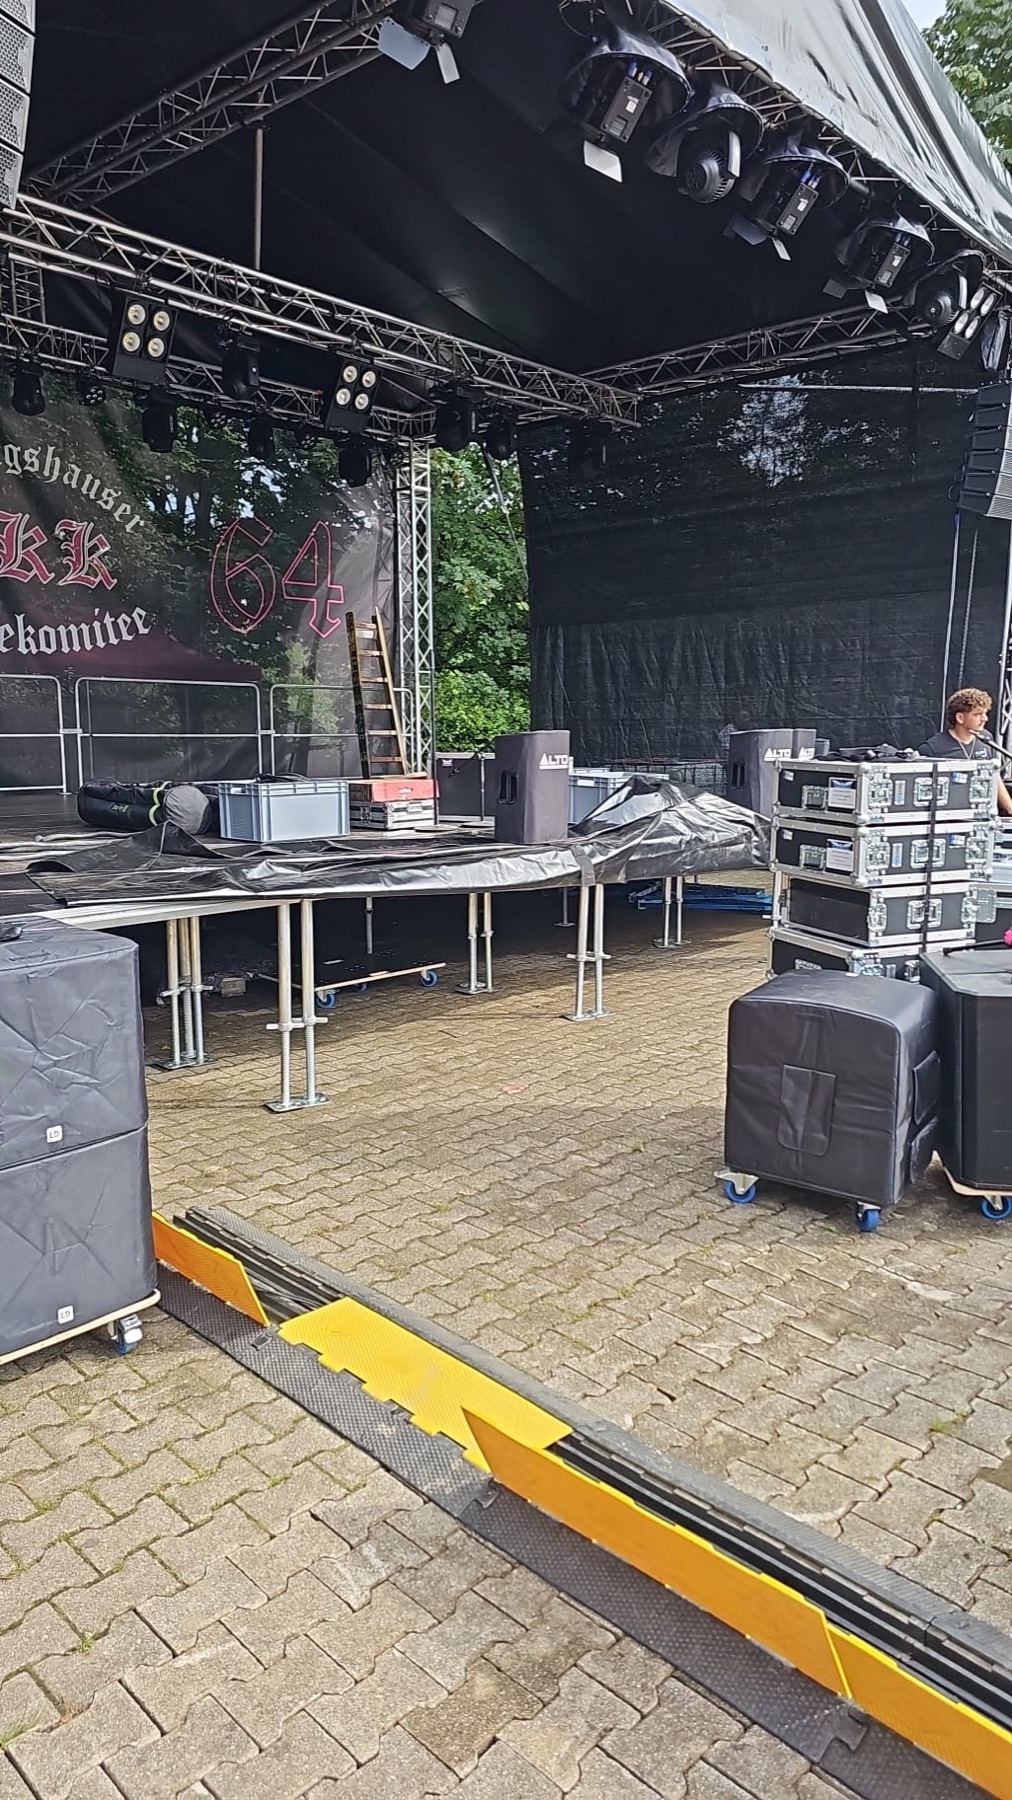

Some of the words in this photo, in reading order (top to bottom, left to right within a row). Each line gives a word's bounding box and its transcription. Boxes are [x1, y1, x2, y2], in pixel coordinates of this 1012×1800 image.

[0, 443, 145, 533] gshauser
[210, 513, 344, 638] 64
[539, 752, 569, 766] ALTO
[764, 747, 791, 759] ALTO
